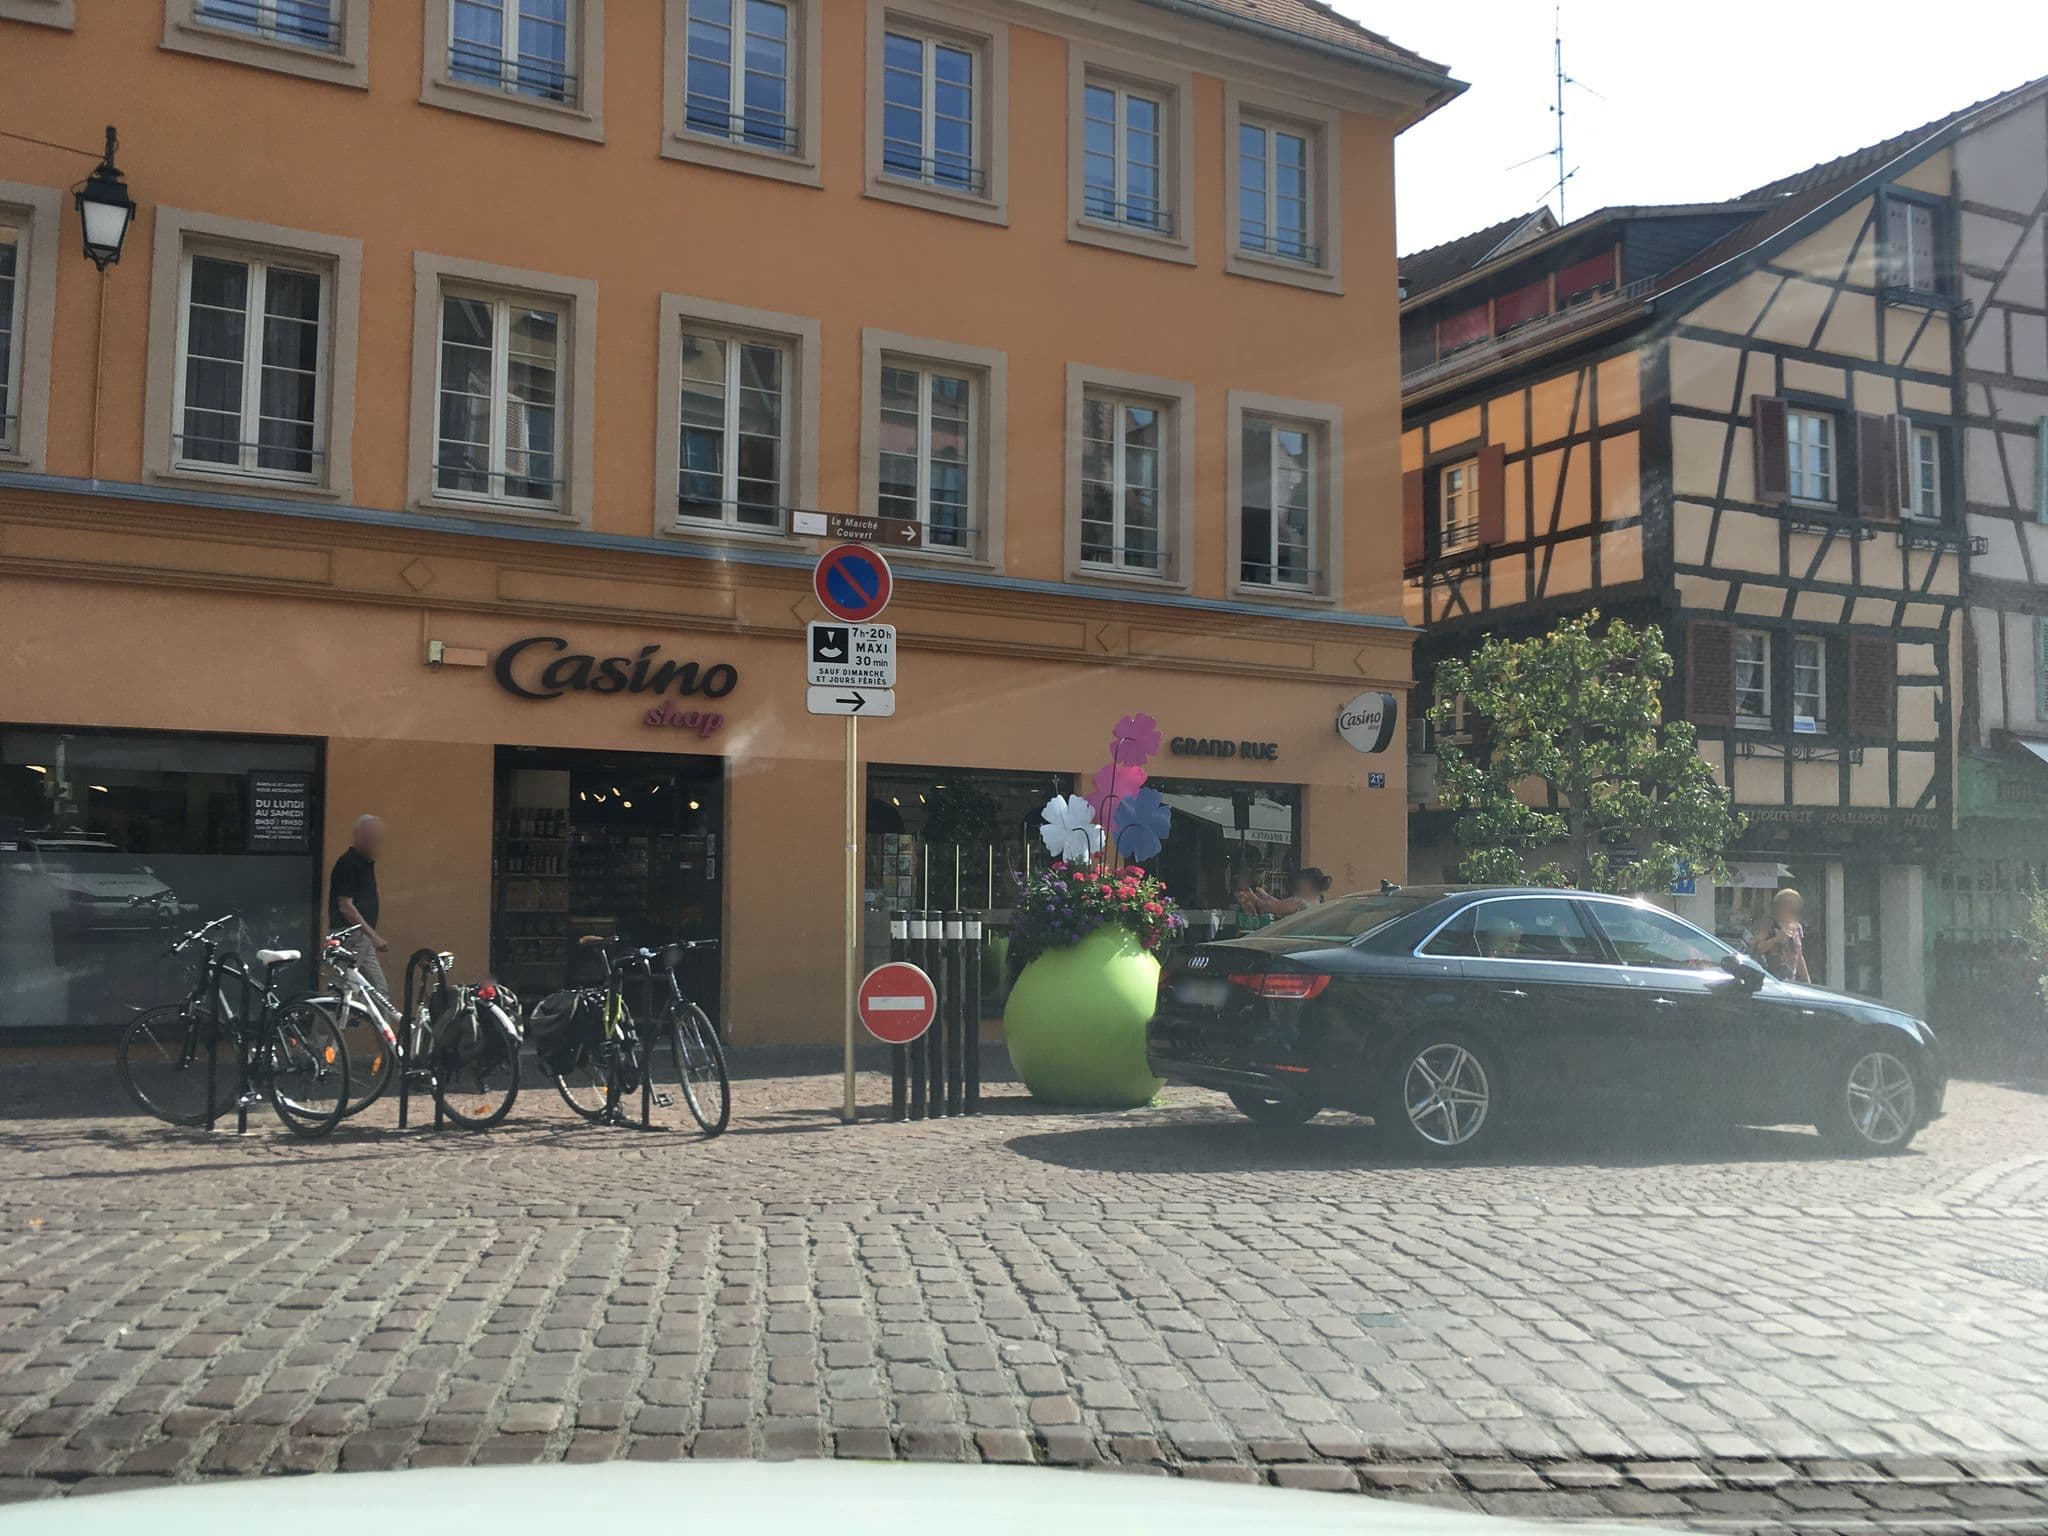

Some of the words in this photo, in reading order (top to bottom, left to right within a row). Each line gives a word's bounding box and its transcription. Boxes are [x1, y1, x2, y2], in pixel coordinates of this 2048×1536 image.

[831, 516, 841, 526] Le
[845, 518, 879, 530] Marché
[836, 527, 873, 539] Couvert
[852, 627, 892, 639] 7h-20h
[856, 643, 888, 654] MAXI
[855, 656, 871, 666] 30
[873, 659, 889, 667] min
[494, 637, 739, 700] Casino
[843, 669, 885, 677] DIMANCHE
[829, 676, 856, 684] JOURS
[858, 676, 887, 685] FÉRIÉS
[644, 701, 725, 738] shop
[1339, 709, 1381, 730] Casino
[1170, 736, 1236, 758] GRAND
[1241, 741, 1279, 761] RUE
[256, 800, 270, 808] DU
[273, 800, 304, 809] LUNDI
[255, 809, 269, 817] AU
[270, 809, 304, 817] SAMEDI
